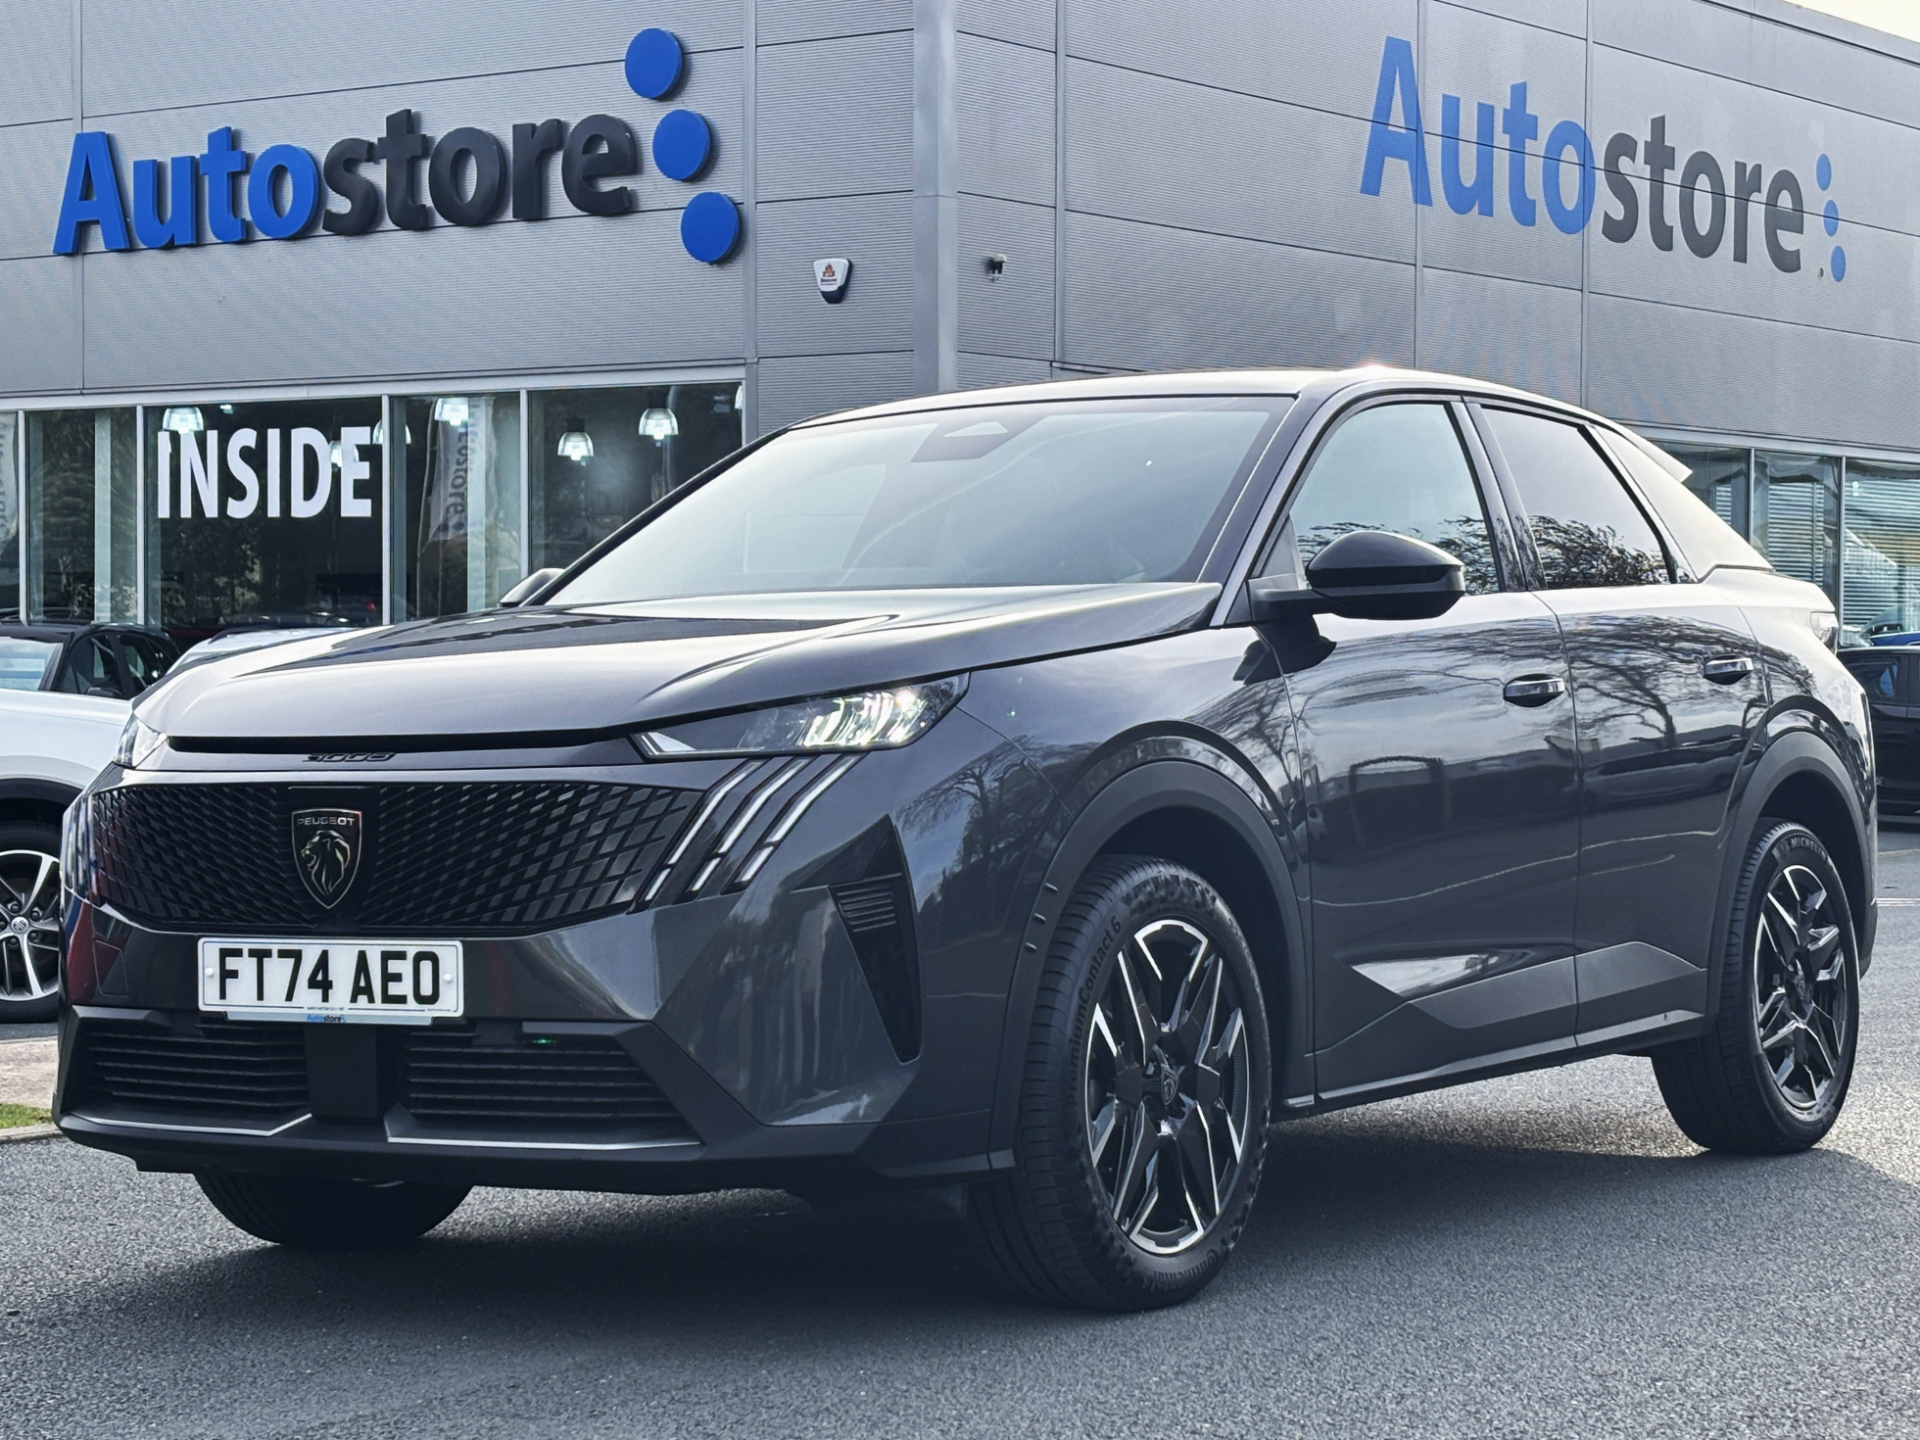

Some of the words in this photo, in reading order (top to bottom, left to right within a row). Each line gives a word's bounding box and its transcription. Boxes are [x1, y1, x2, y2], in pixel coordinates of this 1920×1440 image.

[53, 109, 637, 255] Autostore
[1359, 36, 1804, 273] Autostore
[157, 426, 372, 519] INSIDE
[297, 817, 355, 826] PEUGEOT
[1791, 836, 1827, 861] MICHELIN
[1110, 915, 1122, 934] 6
[218, 947, 333, 1003] FT74
[349, 950, 440, 1005] AEO
